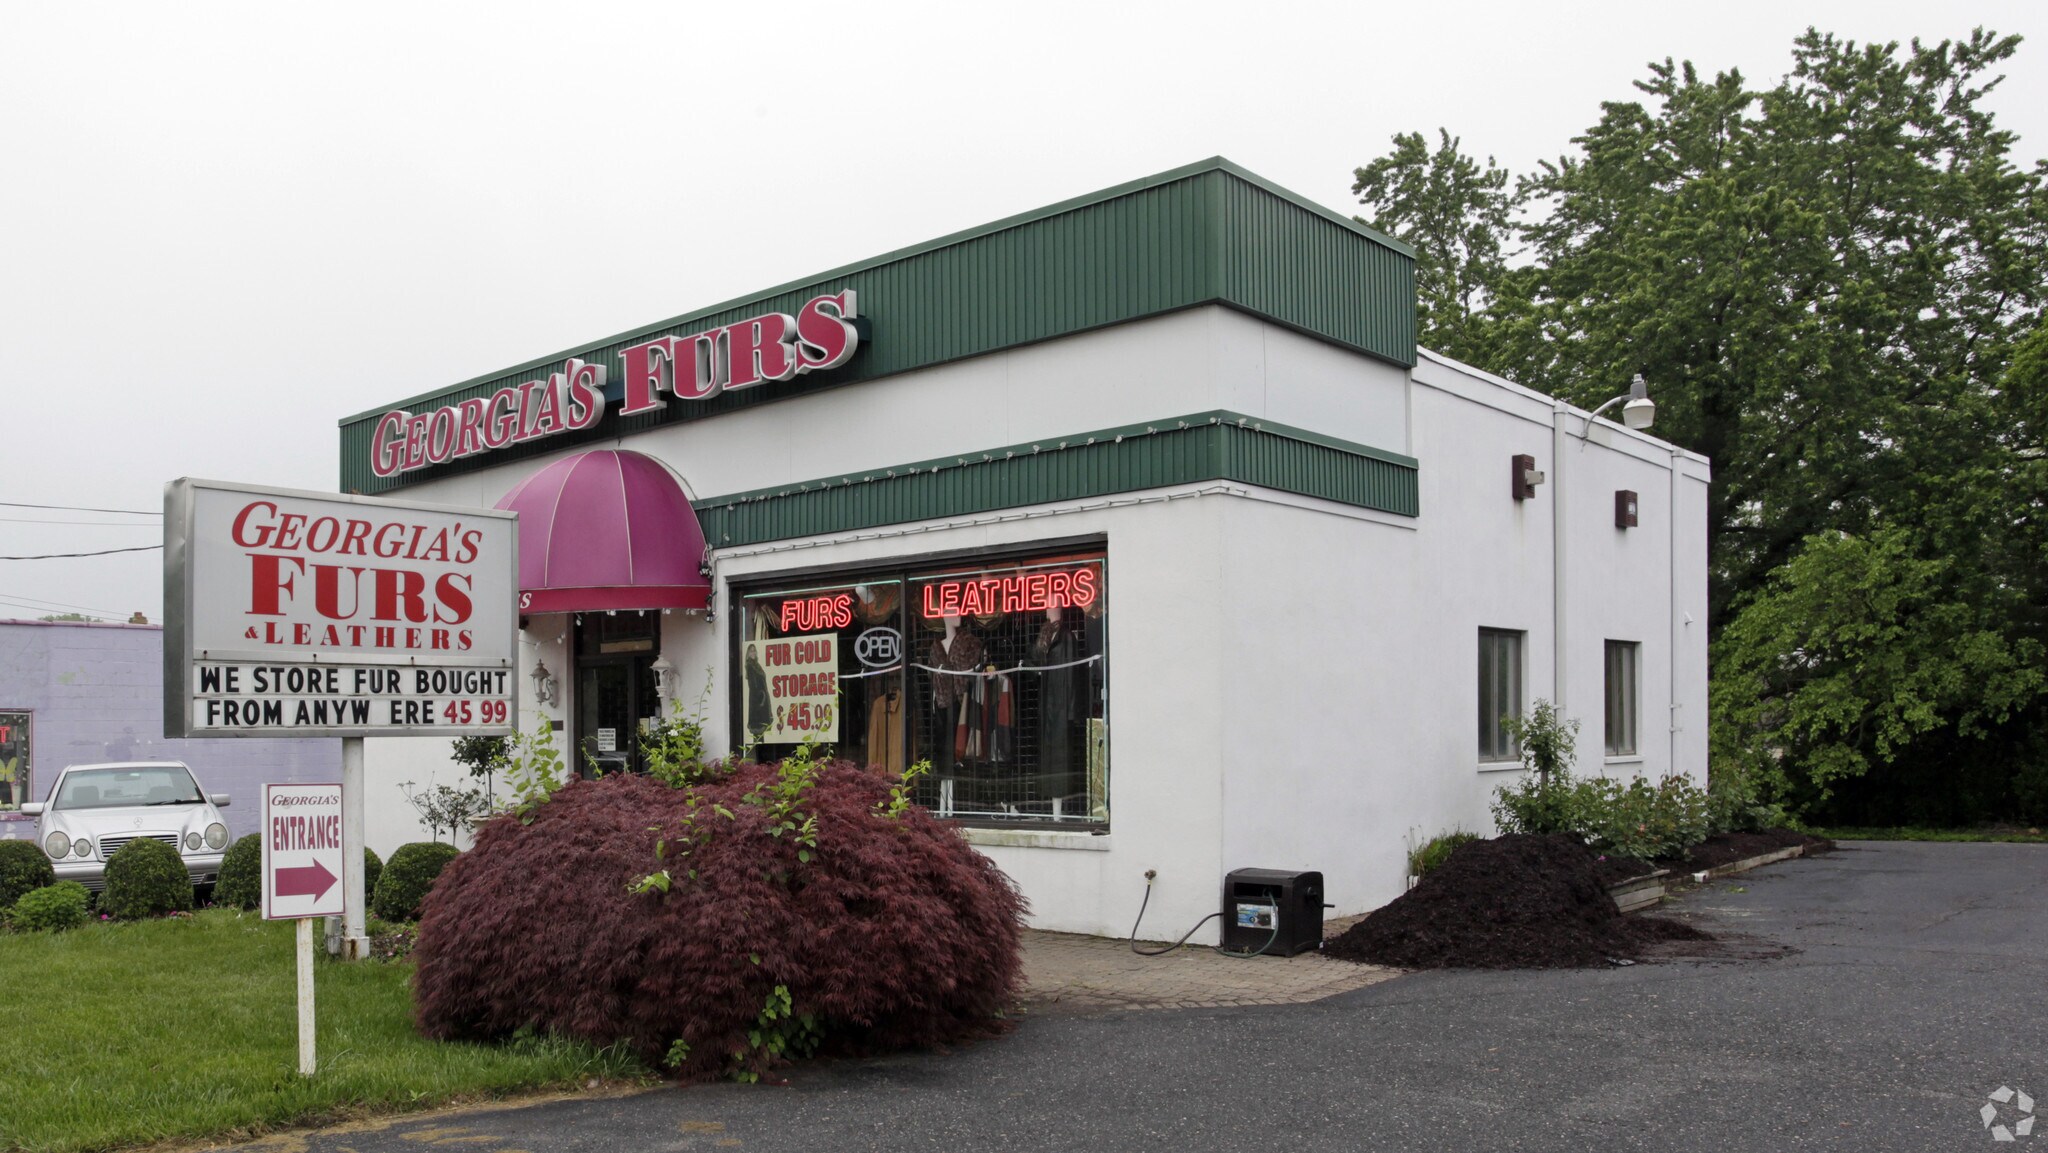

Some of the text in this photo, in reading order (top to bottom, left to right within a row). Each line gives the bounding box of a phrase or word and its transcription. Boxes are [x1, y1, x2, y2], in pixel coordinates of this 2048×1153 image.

[370, 289, 857, 478] GEORGIA'S FURS
[231, 501, 483, 564] GEORGIA'S
[244, 553, 473, 625] FURS
[923, 569, 1096, 619] LEATHERS
[781, 594, 851, 632] FURS
[765, 639, 832, 667] FUR COLD
[859, 636, 902, 658] OPEN
[201, 667, 507, 695] WE STORE FUR BOUGHT
[772, 672, 836, 698] STORAGE
[207, 700, 282, 726] FROM
[271, 794, 340, 807] GEORGIA'S
[273, 815, 340, 851] ENTRANCE
